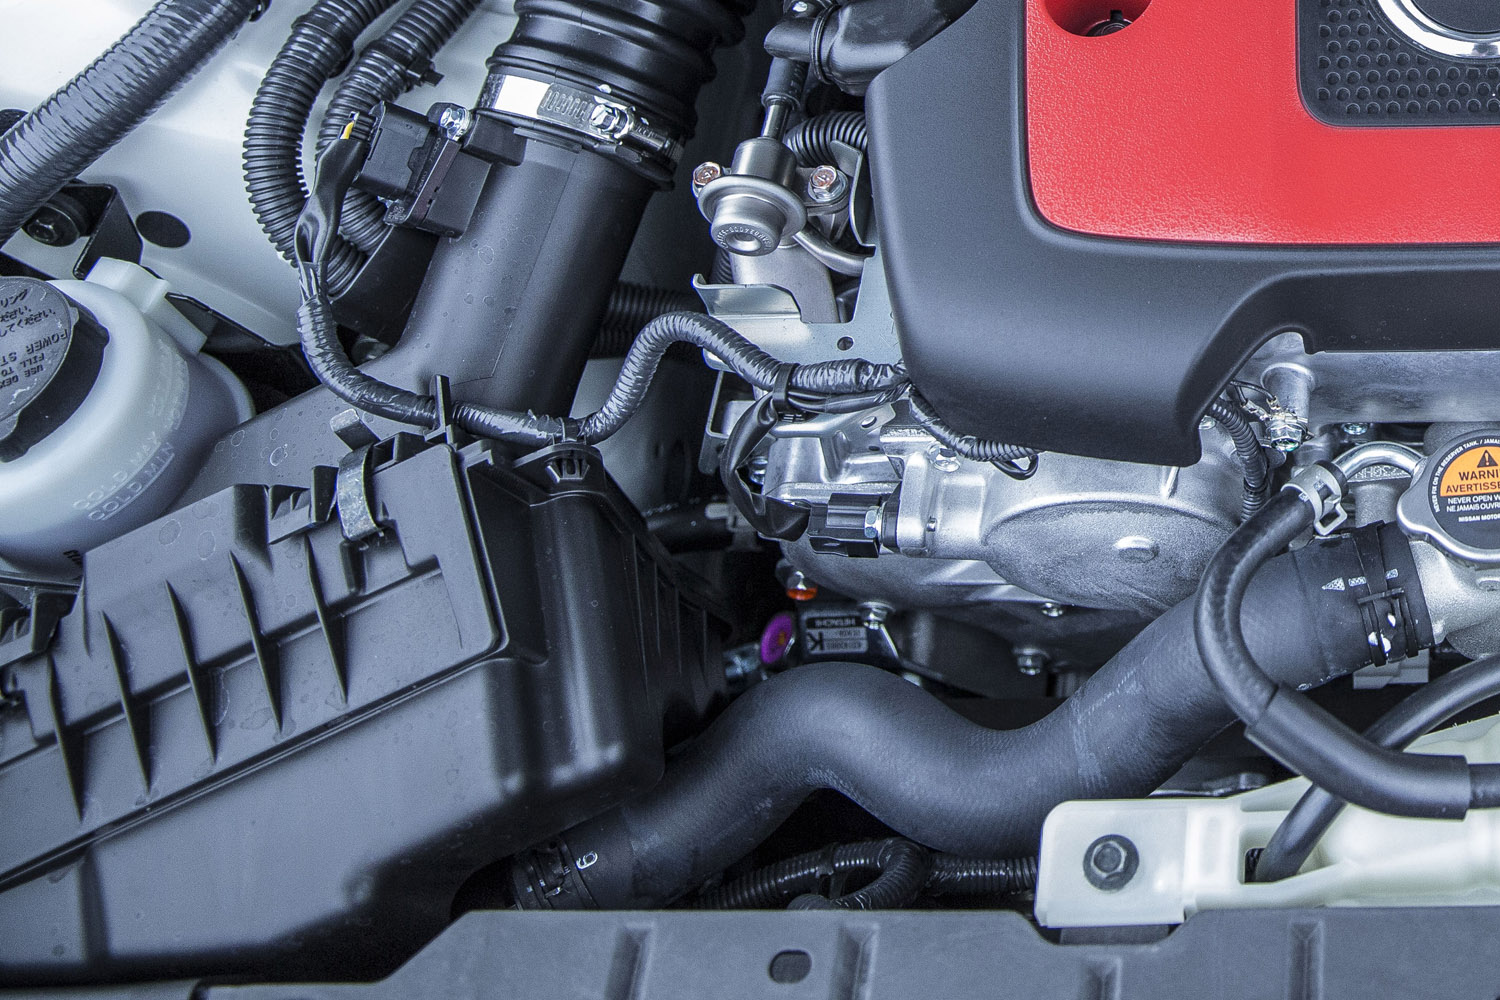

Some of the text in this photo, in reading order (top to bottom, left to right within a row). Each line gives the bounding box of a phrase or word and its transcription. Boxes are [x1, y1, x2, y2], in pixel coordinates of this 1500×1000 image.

[26, 329, 68, 354] POWER
[20, 353, 45, 368] FILL
[24, 365, 44, 378] USE
[1435, 465, 1444, 477] THE
[87, 442, 175, 520] COLD MIN
[1432, 476, 1439, 485] ON
[72, 470, 128, 509] COLD
[1448, 496, 1471, 504] NEVER
[1472, 494, 1492, 502] OPEN
[1457, 504, 1479, 512] JAMAIS
